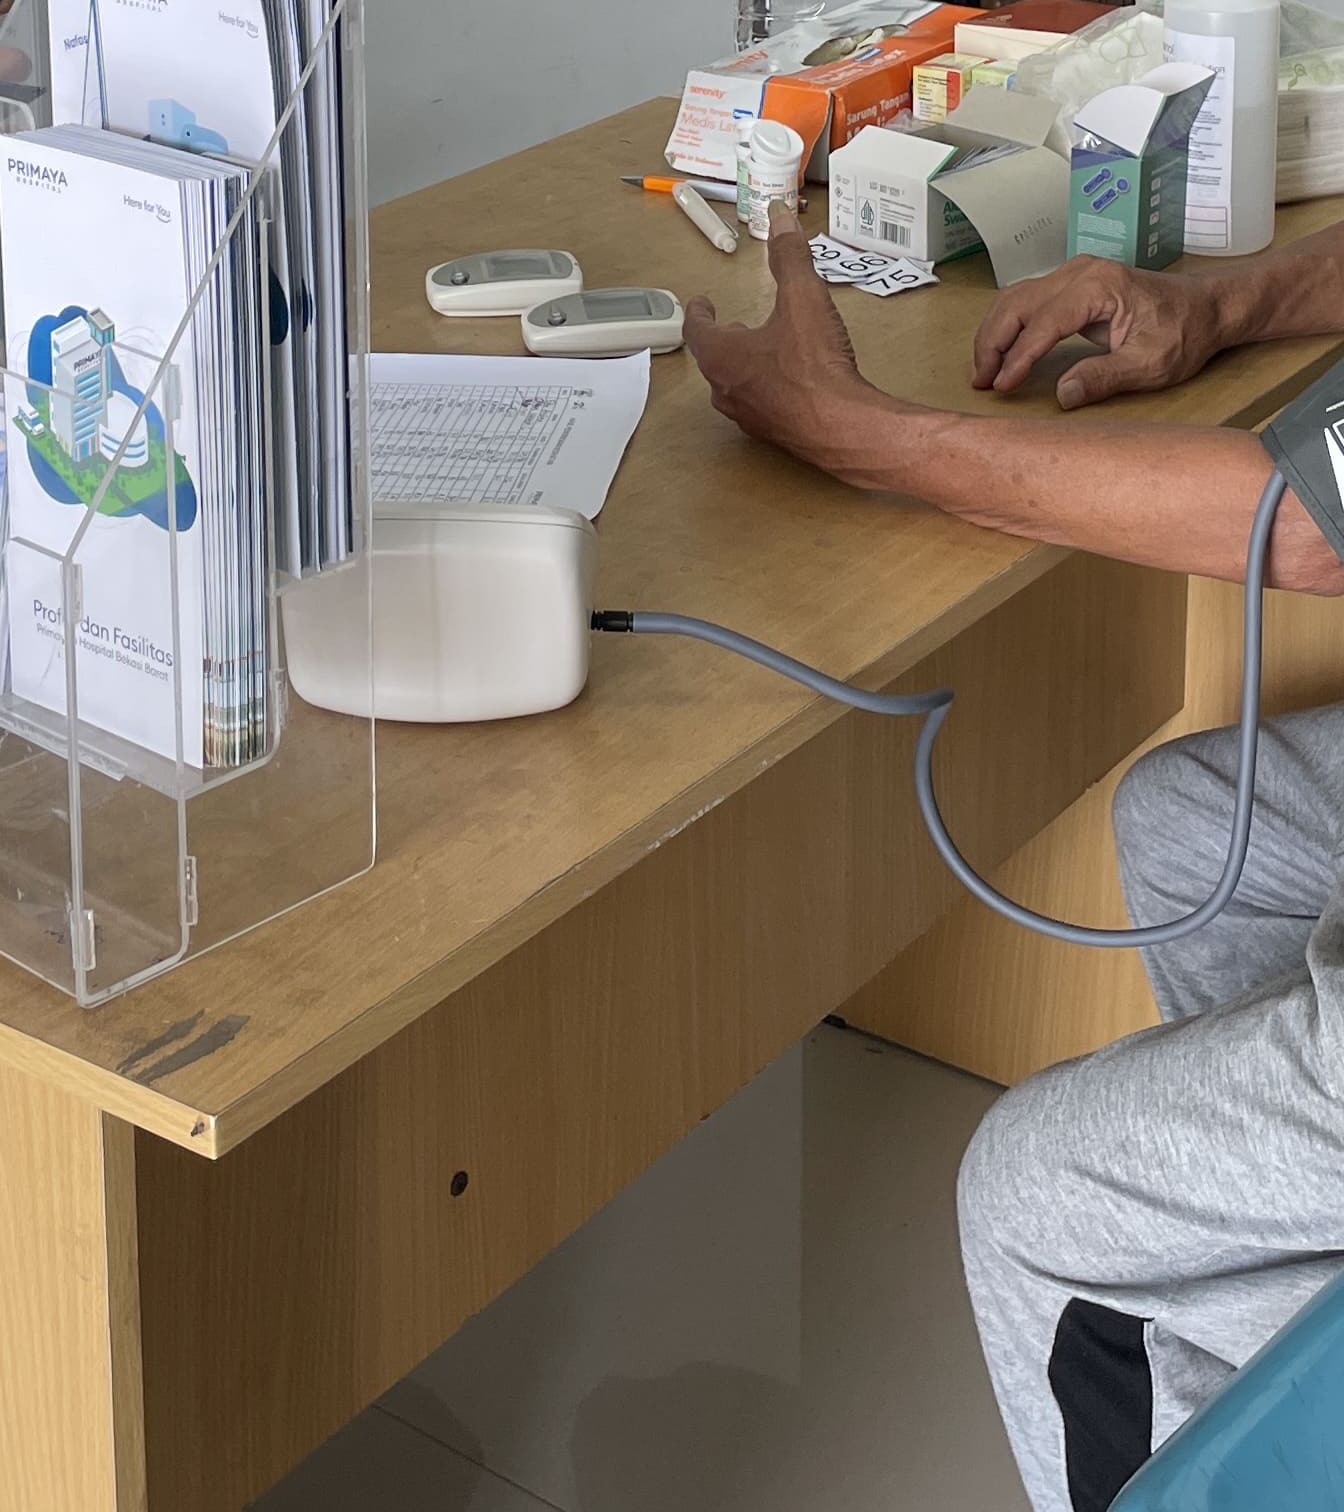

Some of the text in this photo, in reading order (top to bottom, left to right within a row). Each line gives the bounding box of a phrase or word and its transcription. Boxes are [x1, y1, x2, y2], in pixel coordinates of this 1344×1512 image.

[7, 158, 68, 187] PRIMAYA
[865, 269, 919, 289] 75
[79, 616, 110, 642] dan
[113, 627, 173, 667] Fasilitas
[79, 637, 114, 658] Hospital
[115, 650, 144, 670] Bekasi
[144, 662, 169, 682] Barat
